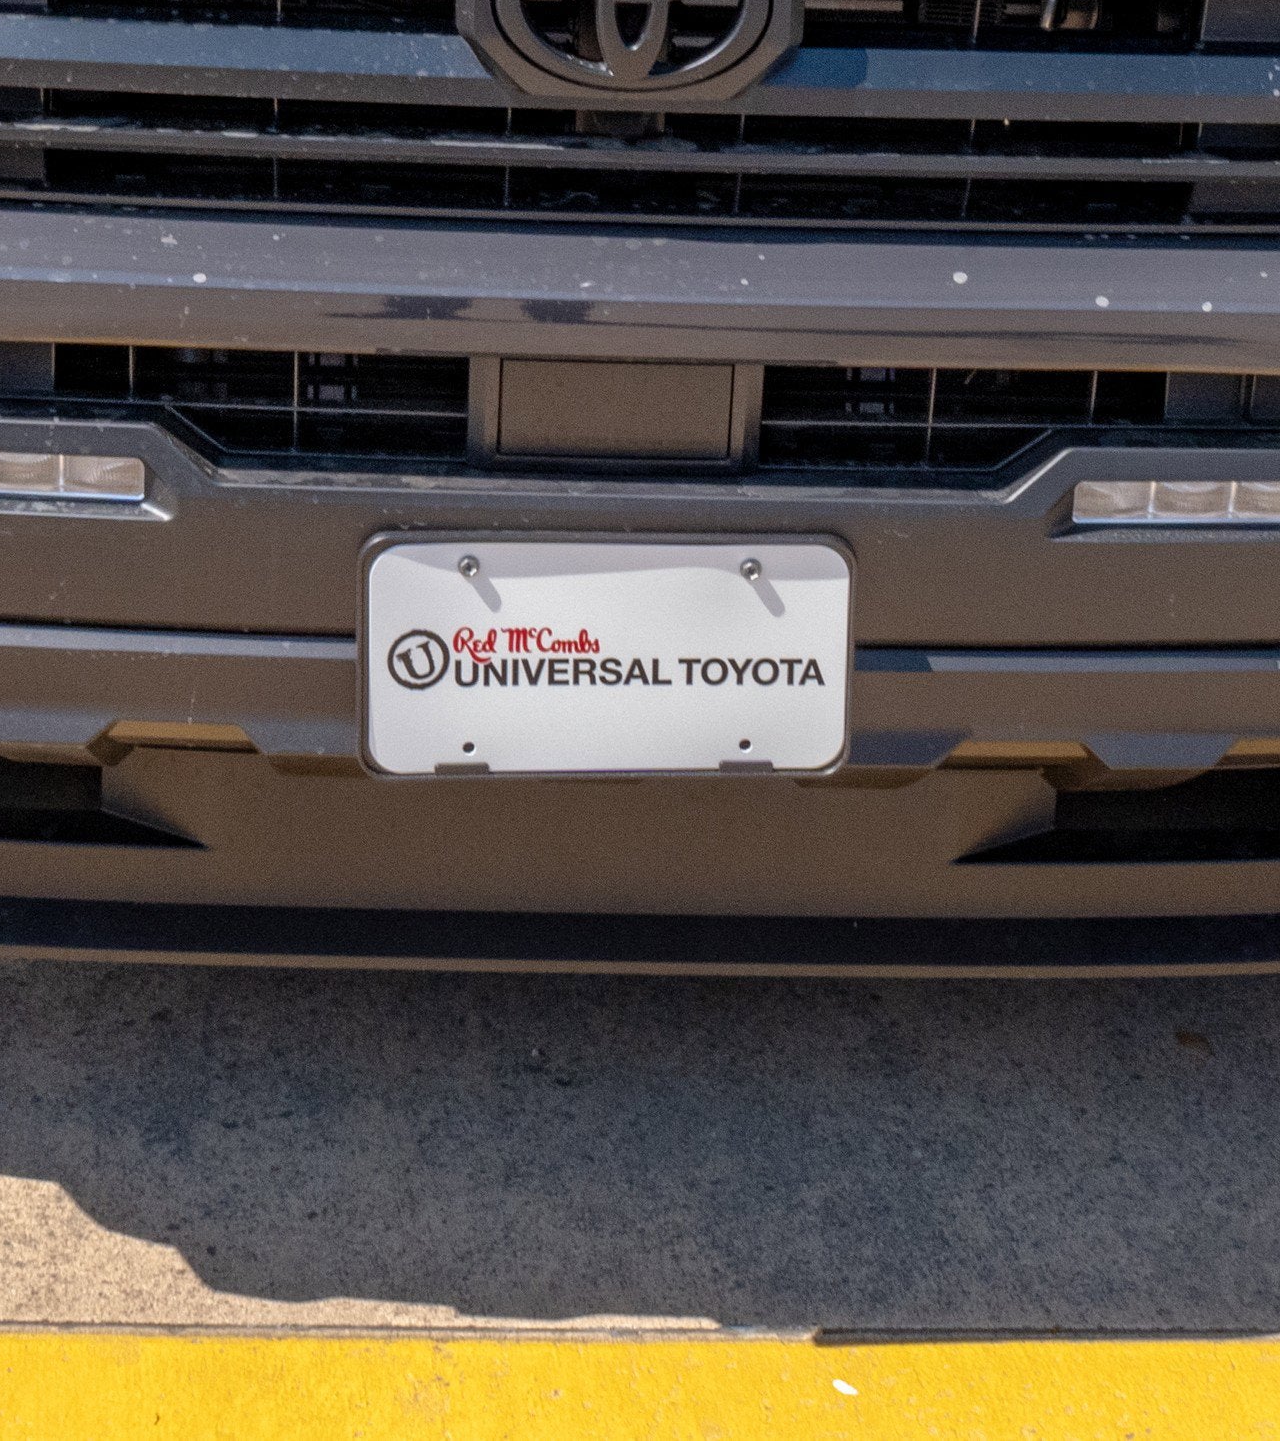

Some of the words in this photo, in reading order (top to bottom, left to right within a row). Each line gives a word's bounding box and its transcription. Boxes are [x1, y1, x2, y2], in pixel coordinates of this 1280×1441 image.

[453, 627, 497, 664] Red
[501, 627, 600, 654] McCombs
[455, 658, 672, 687] UNIVERSAL
[677, 657, 826, 686] TOYOTA
